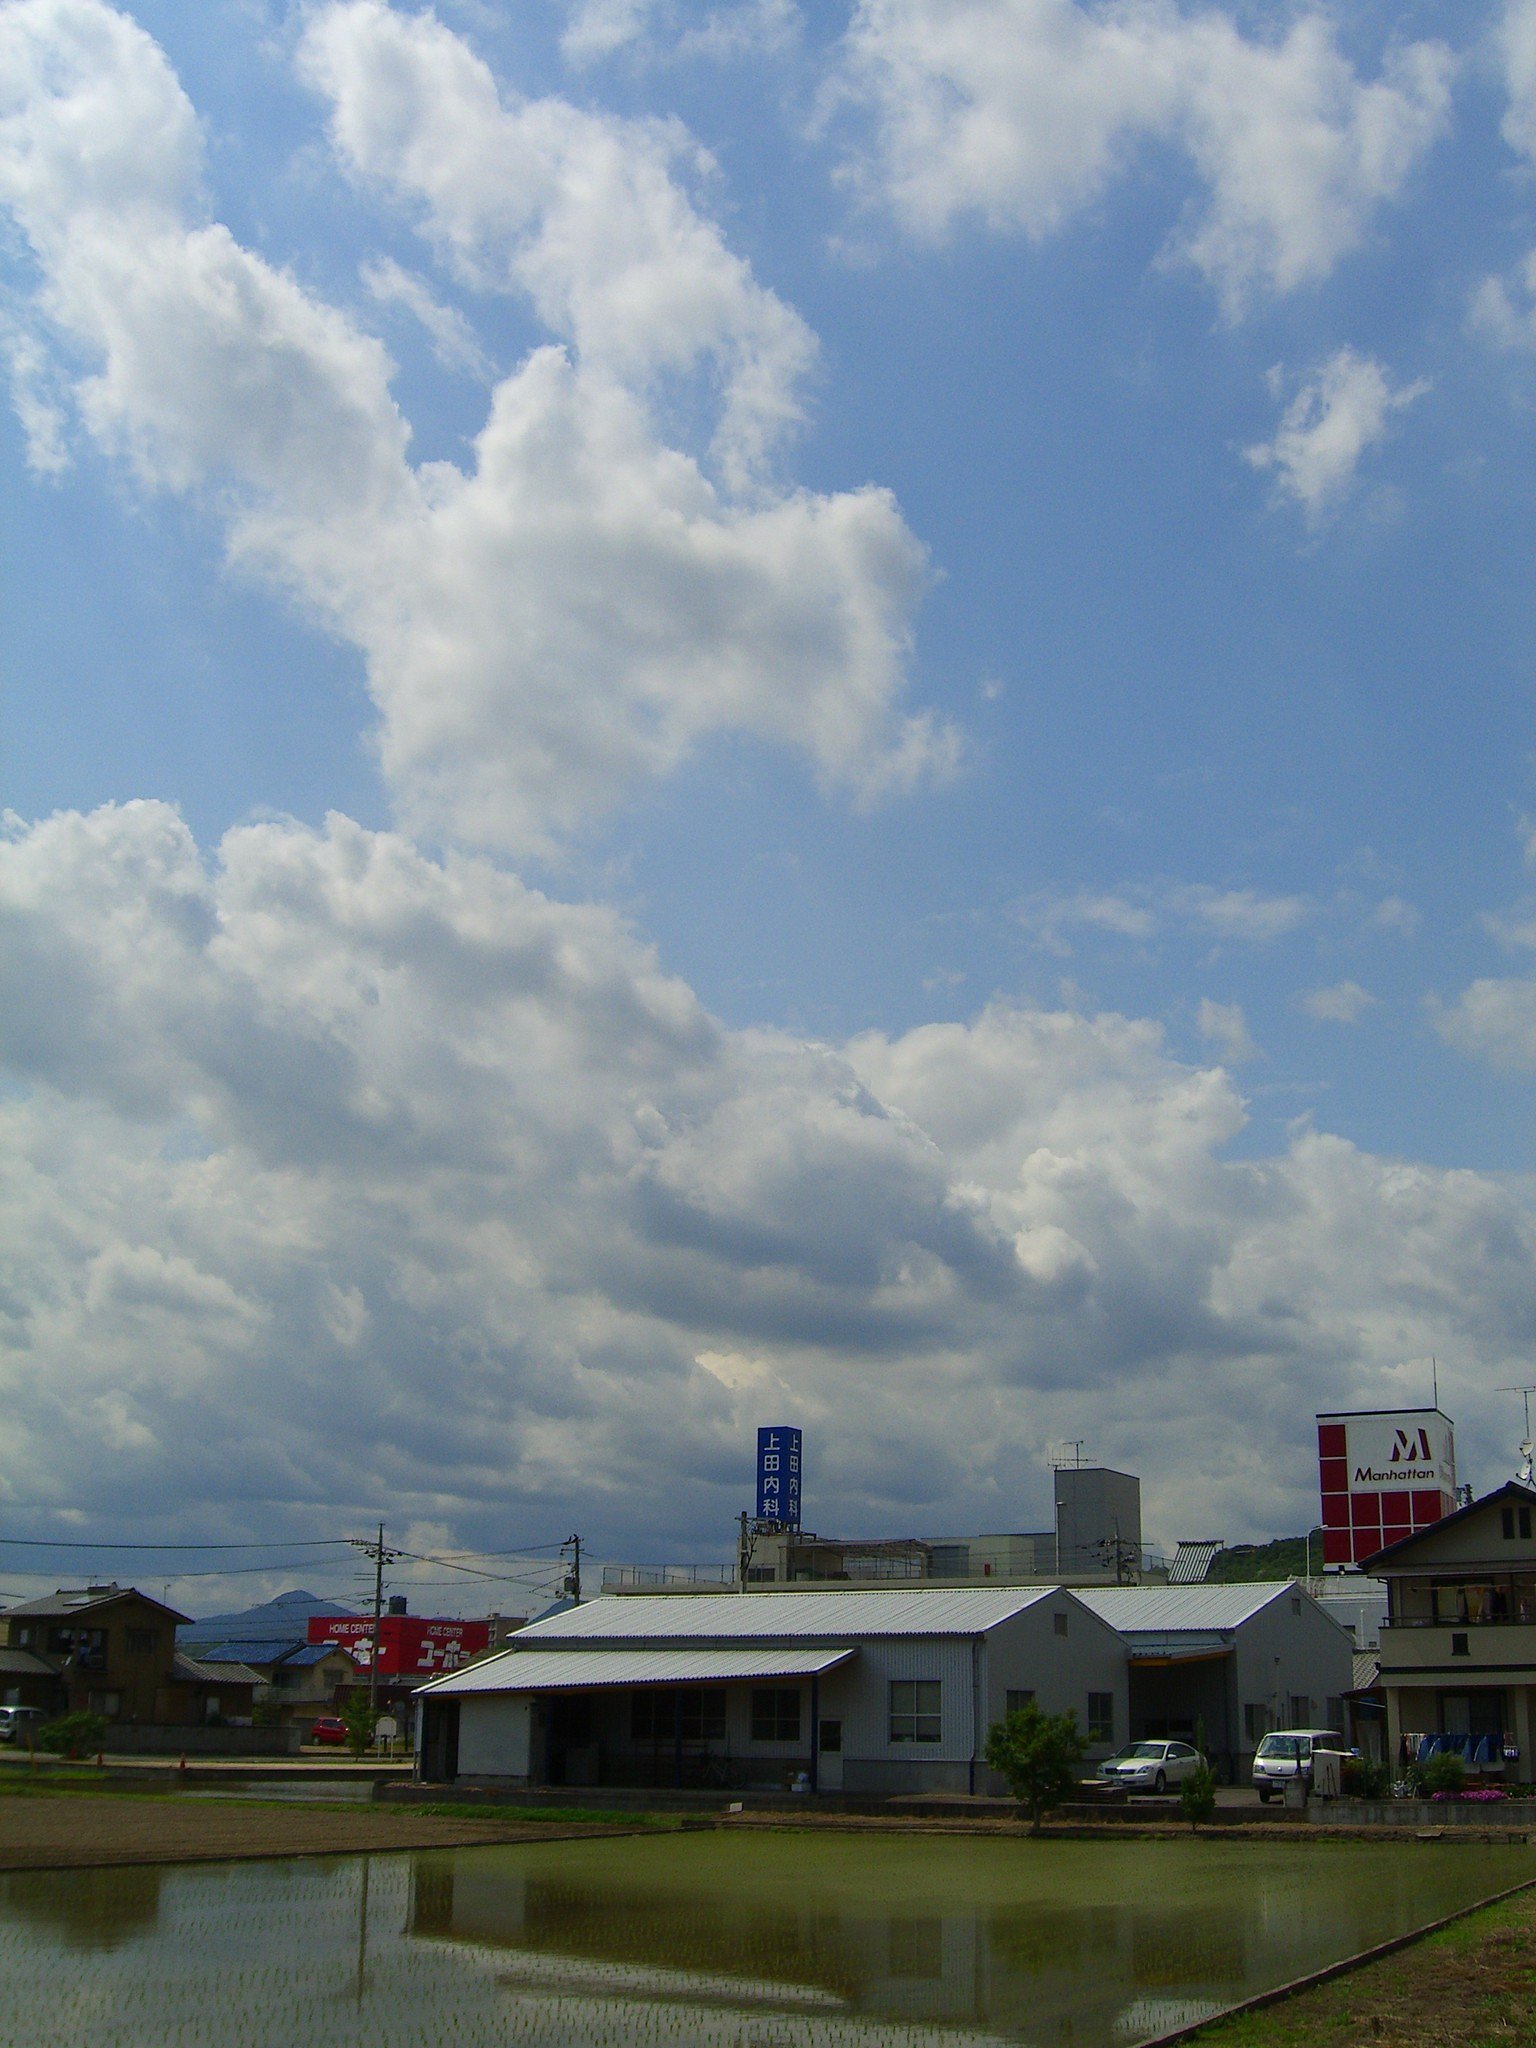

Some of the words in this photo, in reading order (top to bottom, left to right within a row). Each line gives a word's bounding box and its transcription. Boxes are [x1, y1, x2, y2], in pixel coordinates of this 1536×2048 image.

[763, 1432, 780, 1516] 上田内科
[788, 1434, 799, 1517] 上田内科
[1354, 1467, 1435, 1482] Manhattan
[329, 1624, 350, 1634] HOME
[350, 1623, 375, 1633] CENTE
[427, 1626, 442, 1637] HOME
[443, 1627, 463, 1637] CENTER
